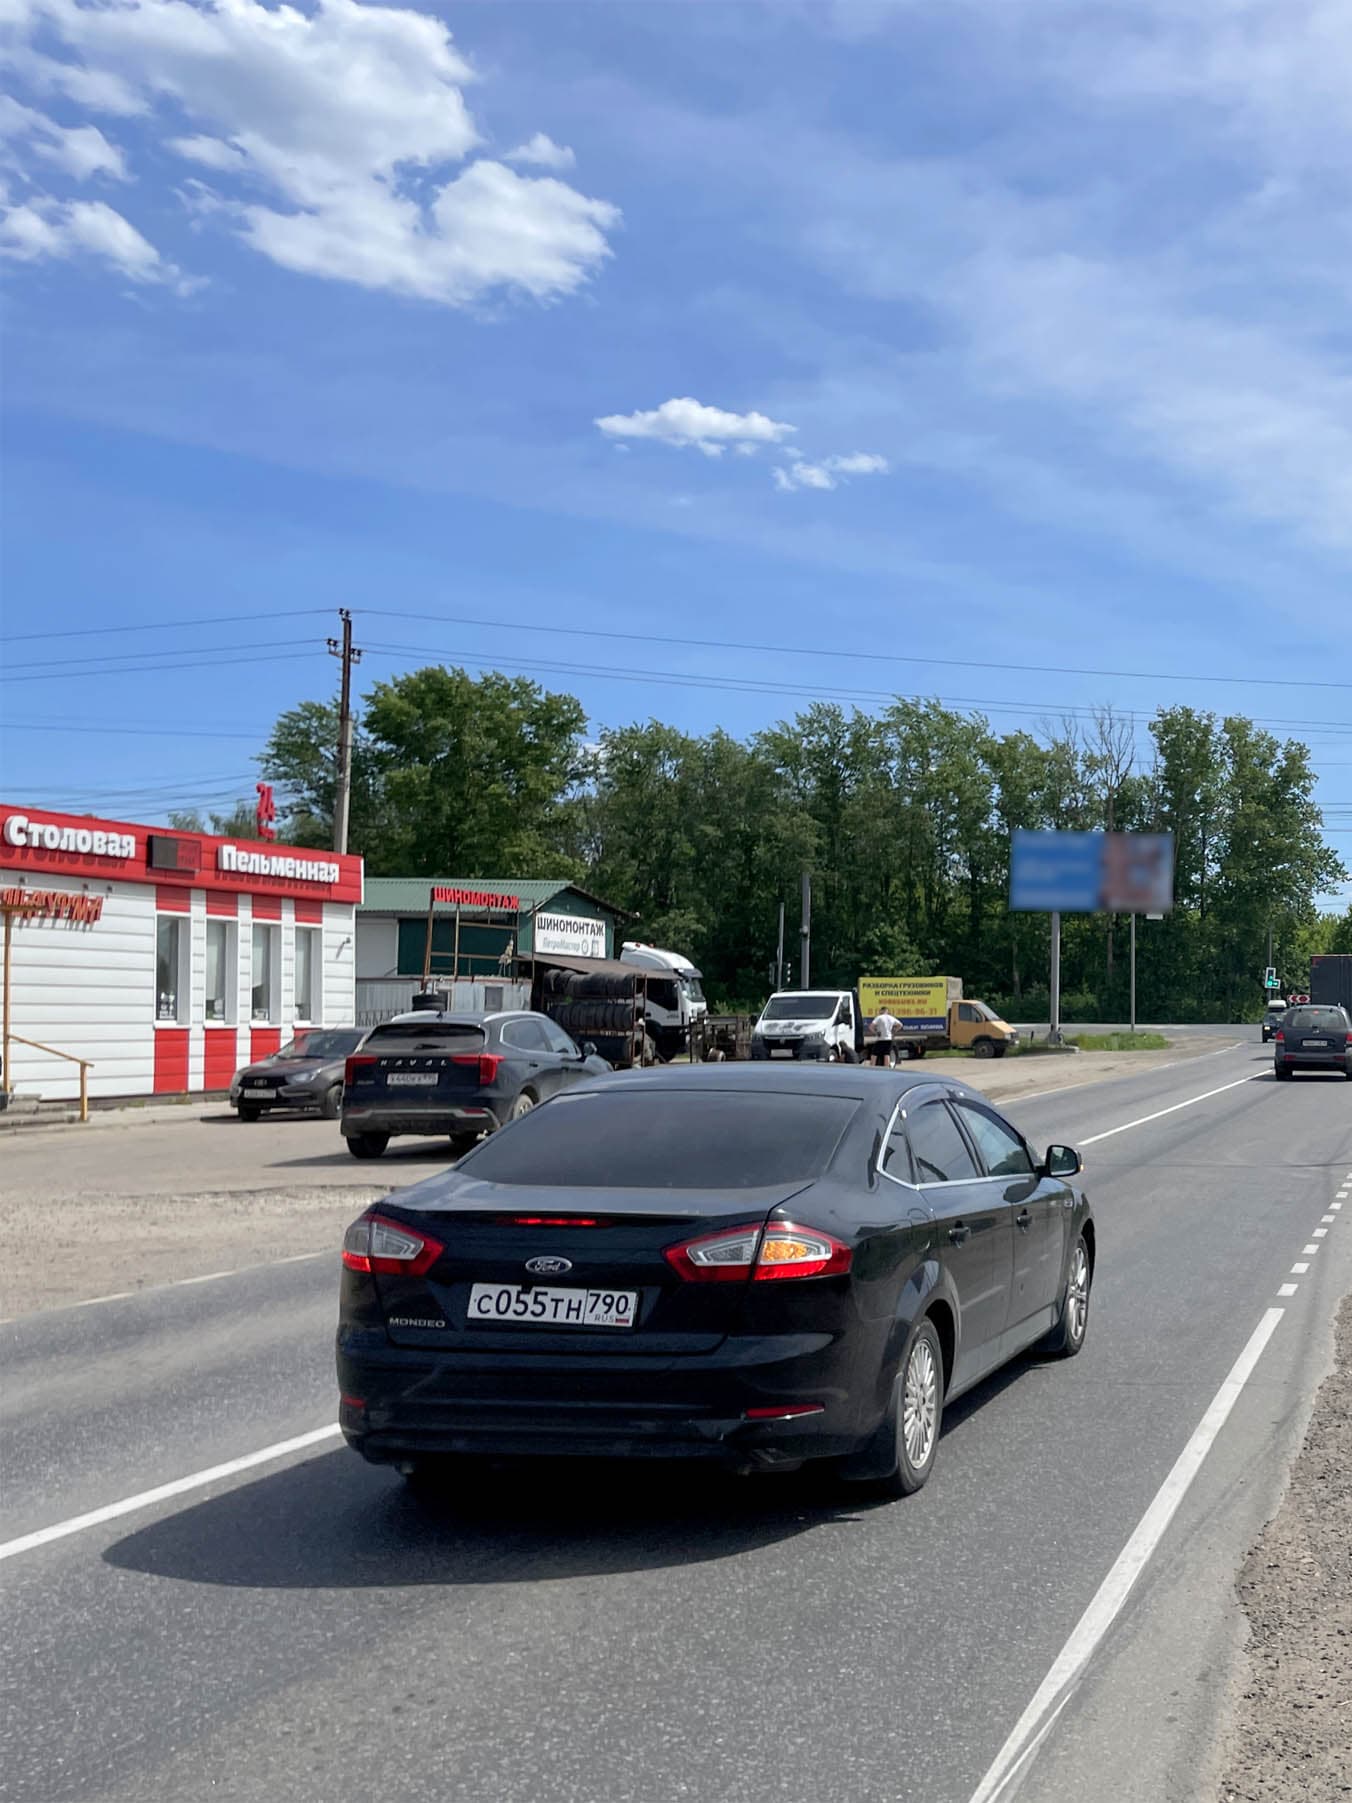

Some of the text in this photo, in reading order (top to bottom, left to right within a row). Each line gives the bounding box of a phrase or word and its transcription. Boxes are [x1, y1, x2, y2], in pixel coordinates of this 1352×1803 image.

[5, 815, 136, 859] Столовая
[219, 844, 340, 884] Пельменная
[433, 887, 520, 910] ШИНОМОНТАЖ
[537, 916, 604, 937] ШИНОМОНТАЖ
[380, 1059, 447, 1067] HAVAL
[533, 1259, 561, 1273] Ford
[588, 1292, 630, 1316] 790
[389, 1317, 446, 1328] MONDEO
[594, 1313, 614, 1323] RUS
